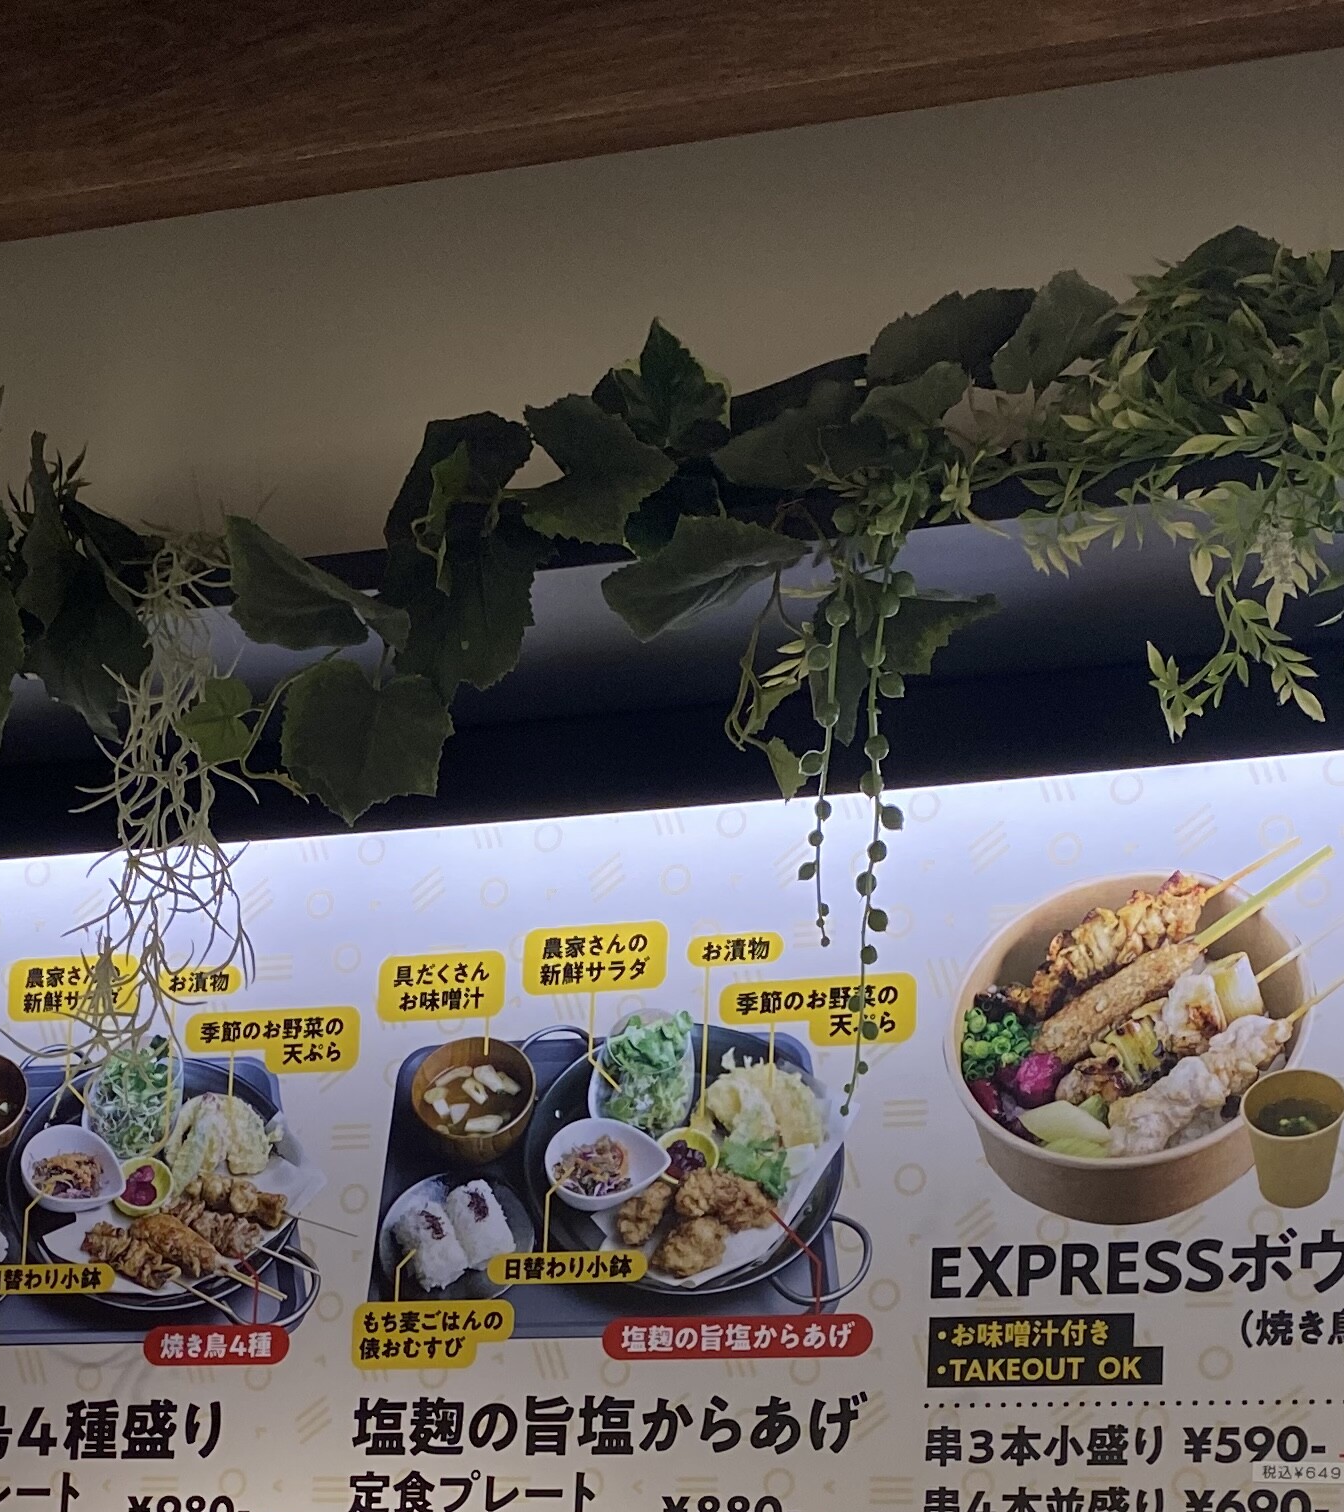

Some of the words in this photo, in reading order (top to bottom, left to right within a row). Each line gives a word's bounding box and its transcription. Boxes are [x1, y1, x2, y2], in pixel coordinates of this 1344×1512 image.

[542, 933, 648, 960] 農家さんの
[701, 938, 770, 962] お漬物
[168, 972, 230, 992] お漬物
[393, 963, 490, 988] 具だくさん
[539, 957, 650, 986] 新鮮サラダ
[398, 988, 485, 1012] お味噌汁
[736, 985, 899, 1016] 季節のお野菜の
[199, 1018, 344, 1043] 季節のお野菜の
[282, 1041, 342, 1065] 天ぷら
[504, 1256, 633, 1280] 日替わり小鉢
[362, 1309, 503, 1333] もち麦ごはんの
[160, 1332, 273, 1359] 焼き鳥4種
[359, 1336, 465, 1360] 俵おむすび
[621, 1322, 855, 1354] 塩麹の旨塩からあげ
[950, 1357, 1086, 1382] TAKEOUT
[1098, 1355, 1141, 1381] OK
[352, 1391, 868, 1456] 塩麹の旨塩からあげ
[924, 1425, 1163, 1467] 串3本小盛り
[1262, 1464, 1342, 1481] 税込¥649
